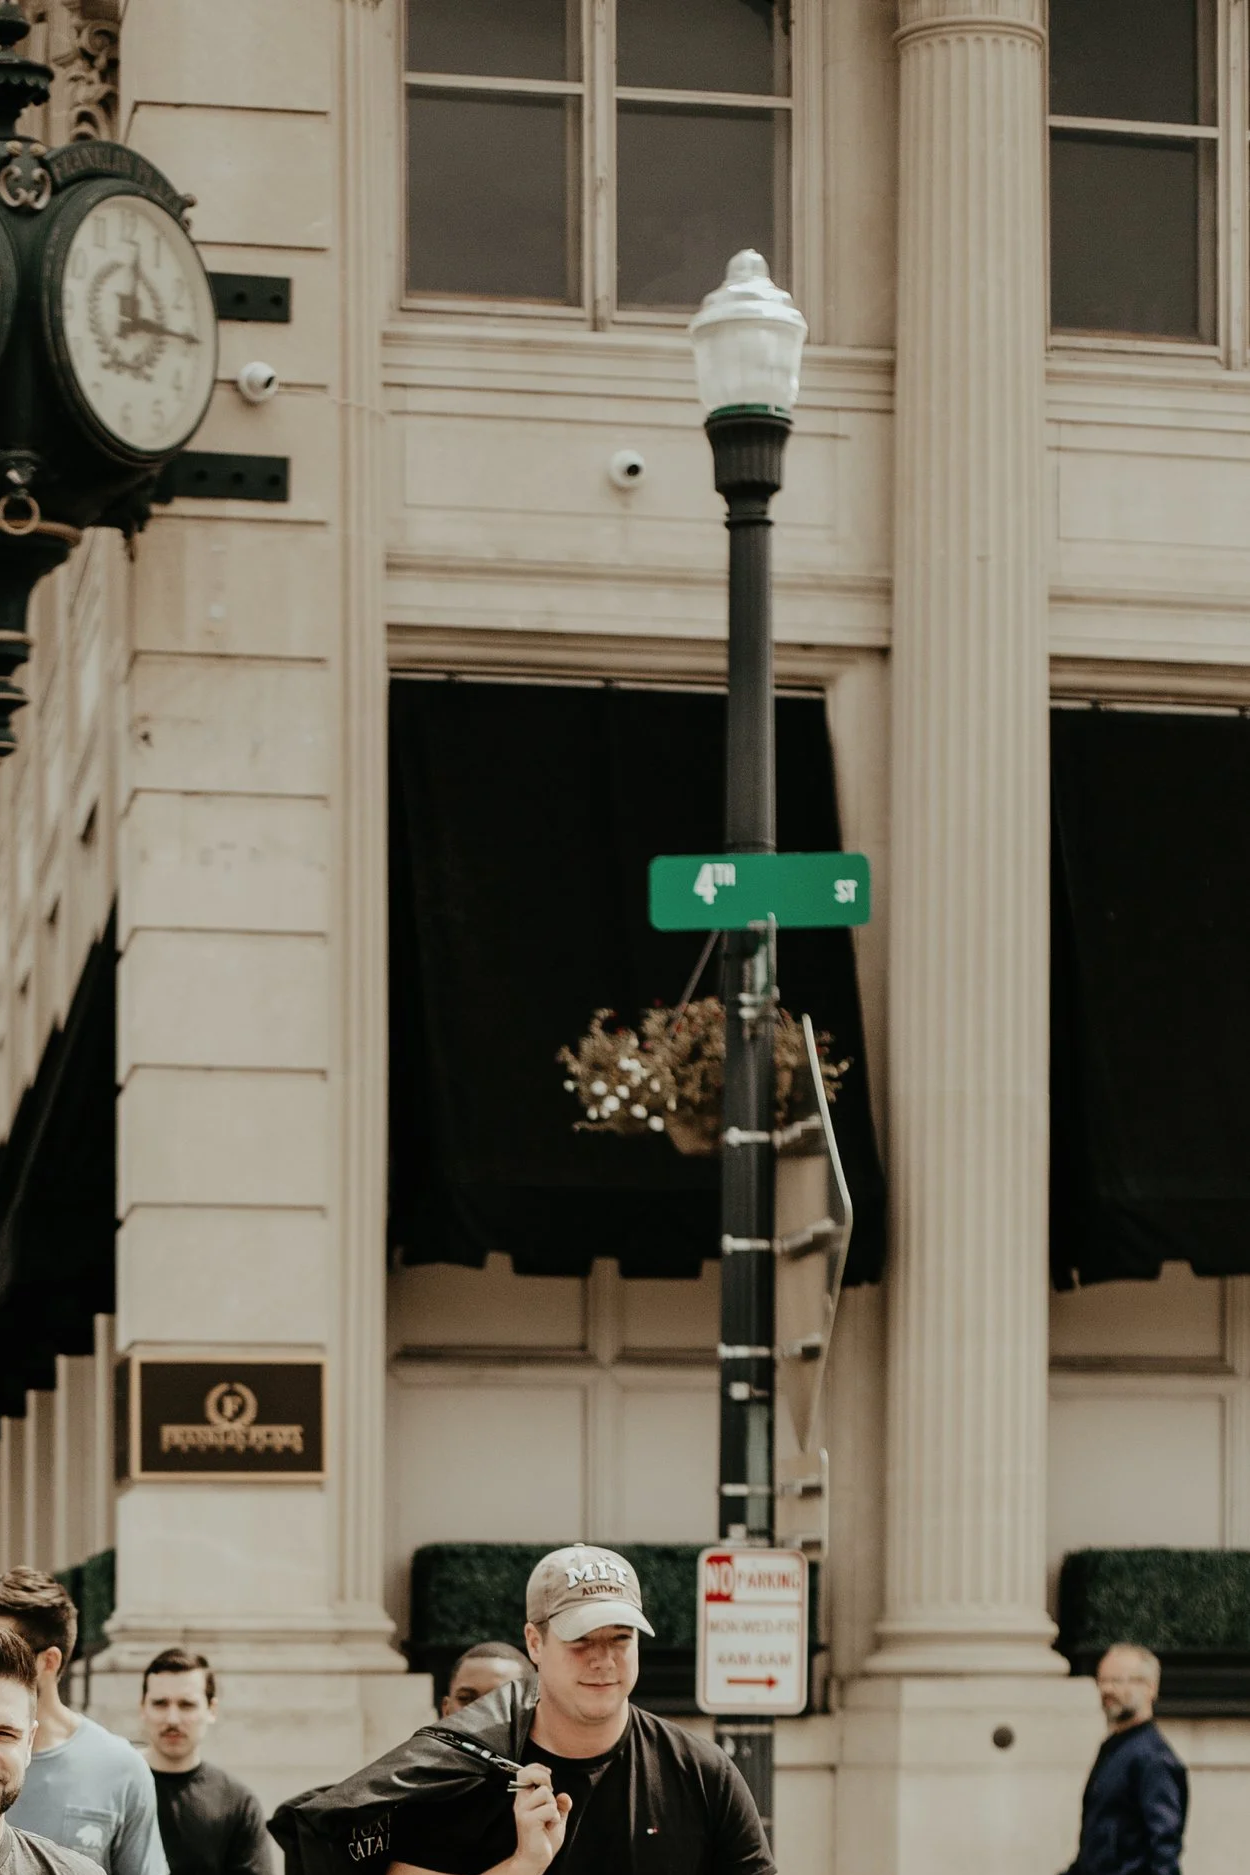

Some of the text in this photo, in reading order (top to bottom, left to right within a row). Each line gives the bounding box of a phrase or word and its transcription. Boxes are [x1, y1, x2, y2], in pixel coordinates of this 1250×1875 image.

[833, 878, 859, 903] ST
[565, 1562, 627, 1590] MIT
[706, 1561, 800, 1596] NO PARKING
[582, 1585, 623, 1597] ALUMNI
